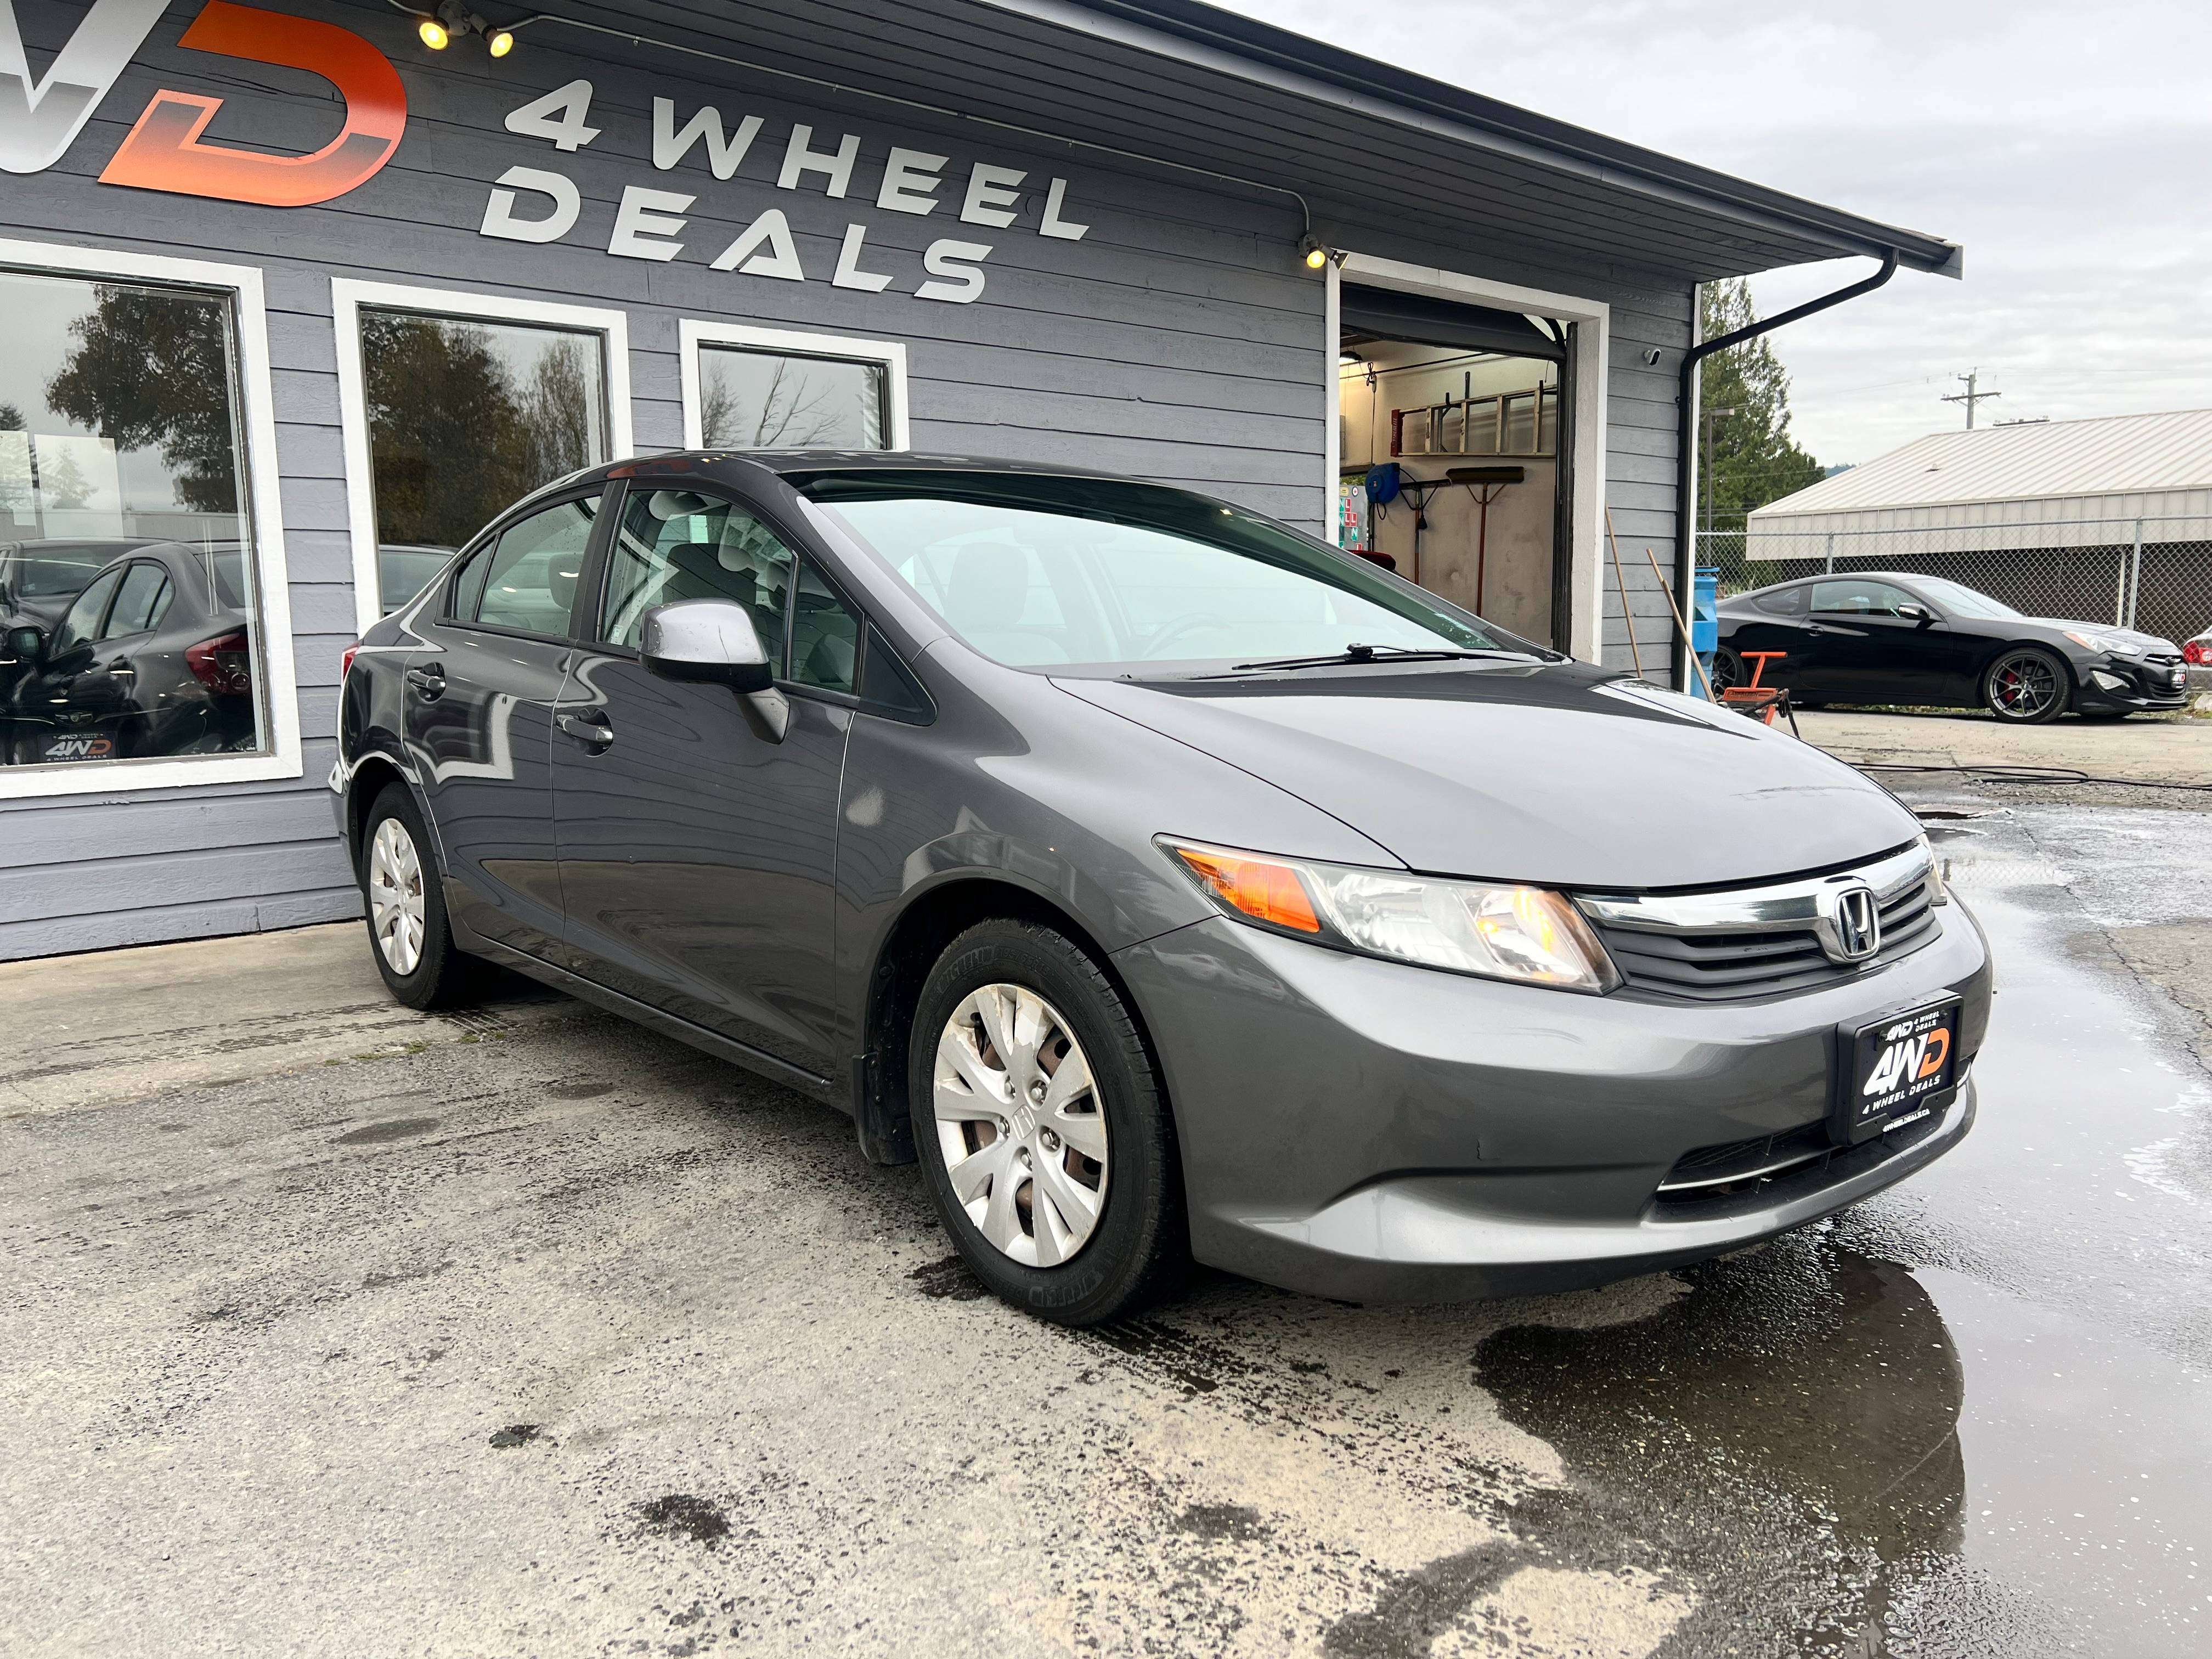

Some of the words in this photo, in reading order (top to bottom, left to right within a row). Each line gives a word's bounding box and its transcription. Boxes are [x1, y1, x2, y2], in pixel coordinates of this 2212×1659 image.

[504, 80, 601, 151] 4
[653, 96, 1090, 240] WHEEL
[480, 166, 994, 303] DEALS
[1915, 1019, 1937, 1032] DEALS
[1920, 1011, 1939, 1023] WHEEL
[1863, 1028, 1950, 1096] 4WD
[1862, 1104, 1870, 1115] 4
[1872, 1090, 1905, 1111] WHEEL
[1909, 1075, 1940, 1096] DEALS
